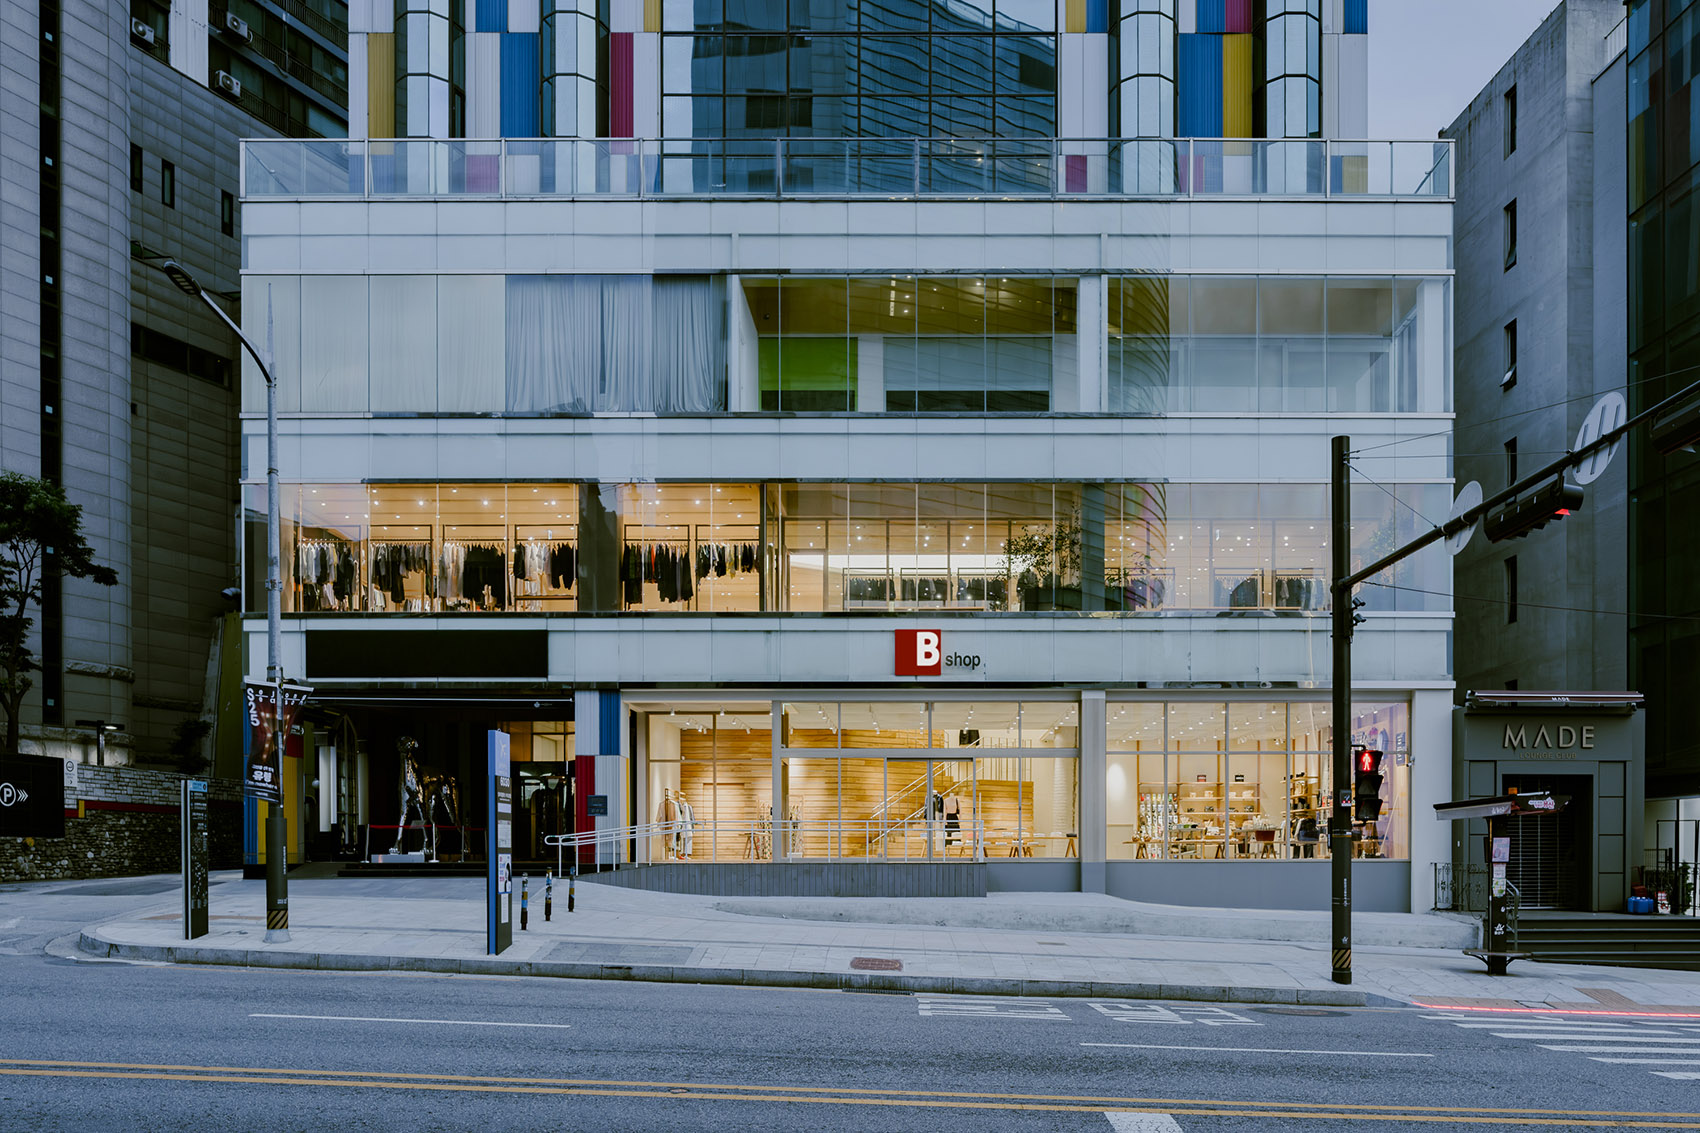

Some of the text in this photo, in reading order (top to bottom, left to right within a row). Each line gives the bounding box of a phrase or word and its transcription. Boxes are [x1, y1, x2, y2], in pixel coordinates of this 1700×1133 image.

[917, 631, 981, 670] B shop
[1504, 724, 1595, 748] MADE
[4, 788, 12, 802] P
